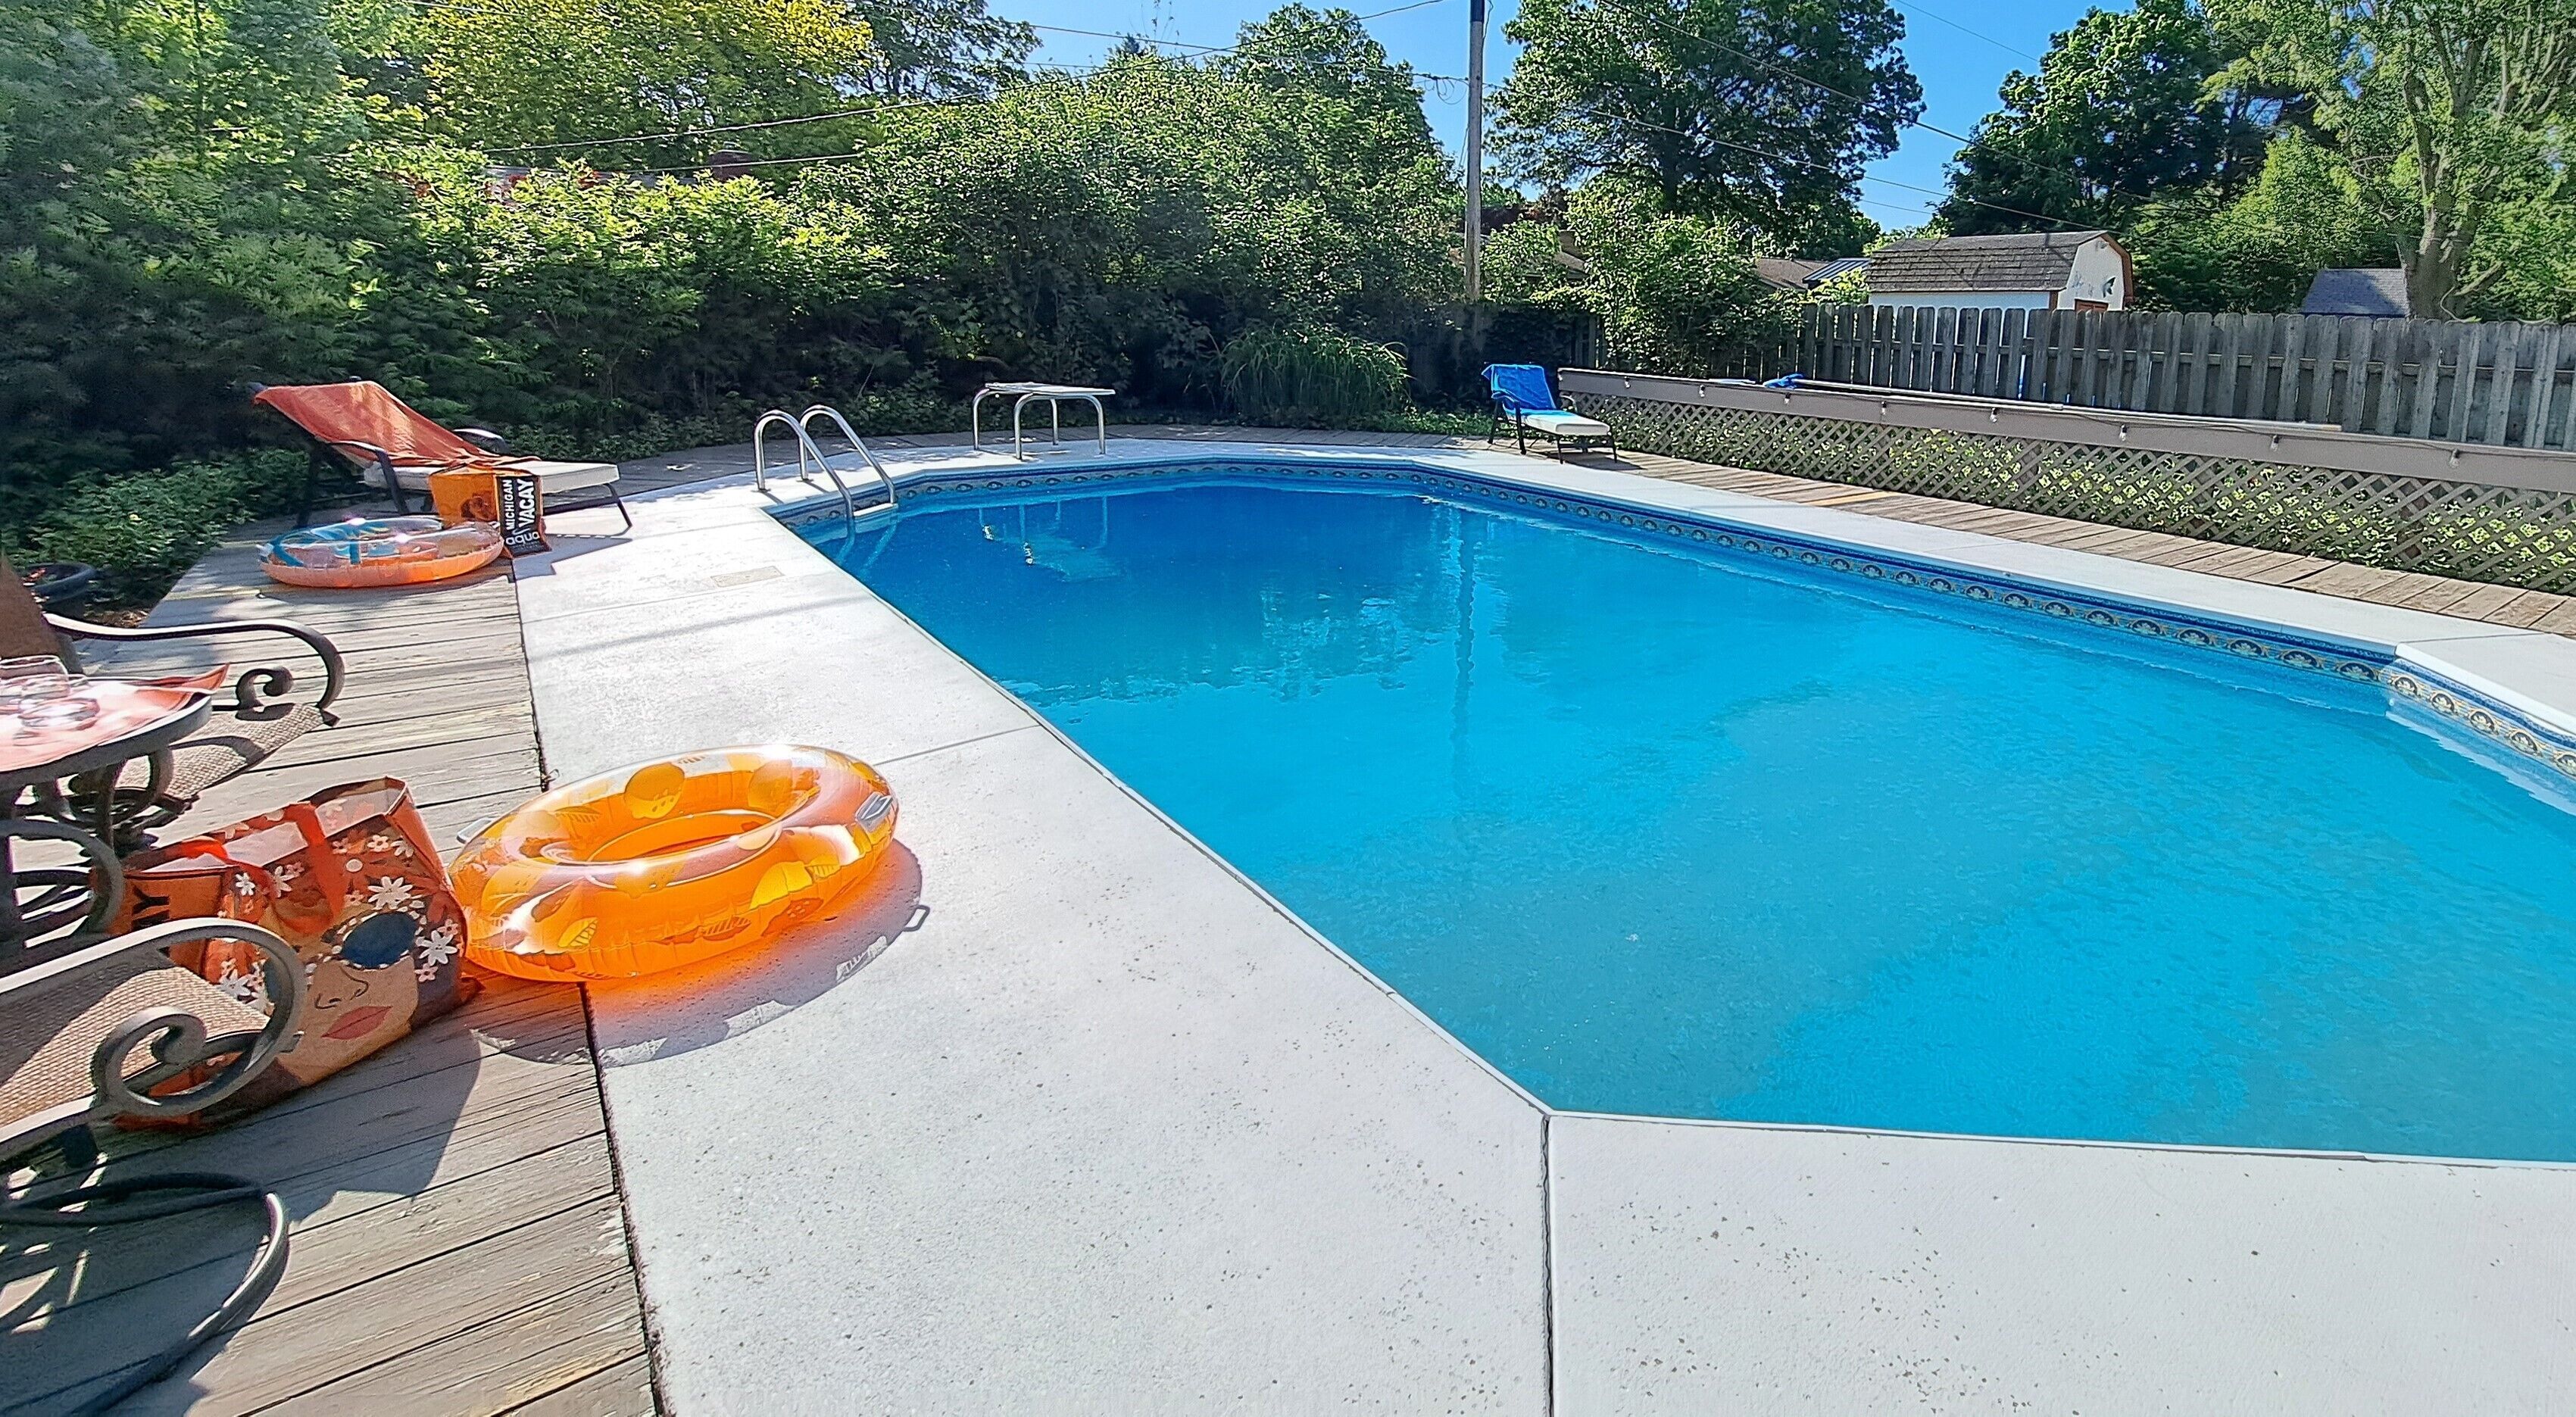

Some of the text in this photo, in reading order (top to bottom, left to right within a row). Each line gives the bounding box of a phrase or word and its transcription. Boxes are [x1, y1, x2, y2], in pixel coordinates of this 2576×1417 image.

[502, 479, 515, 530] MICHIGAN
[517, 479, 535, 528] VACAY
[505, 532, 540, 545] aqua
